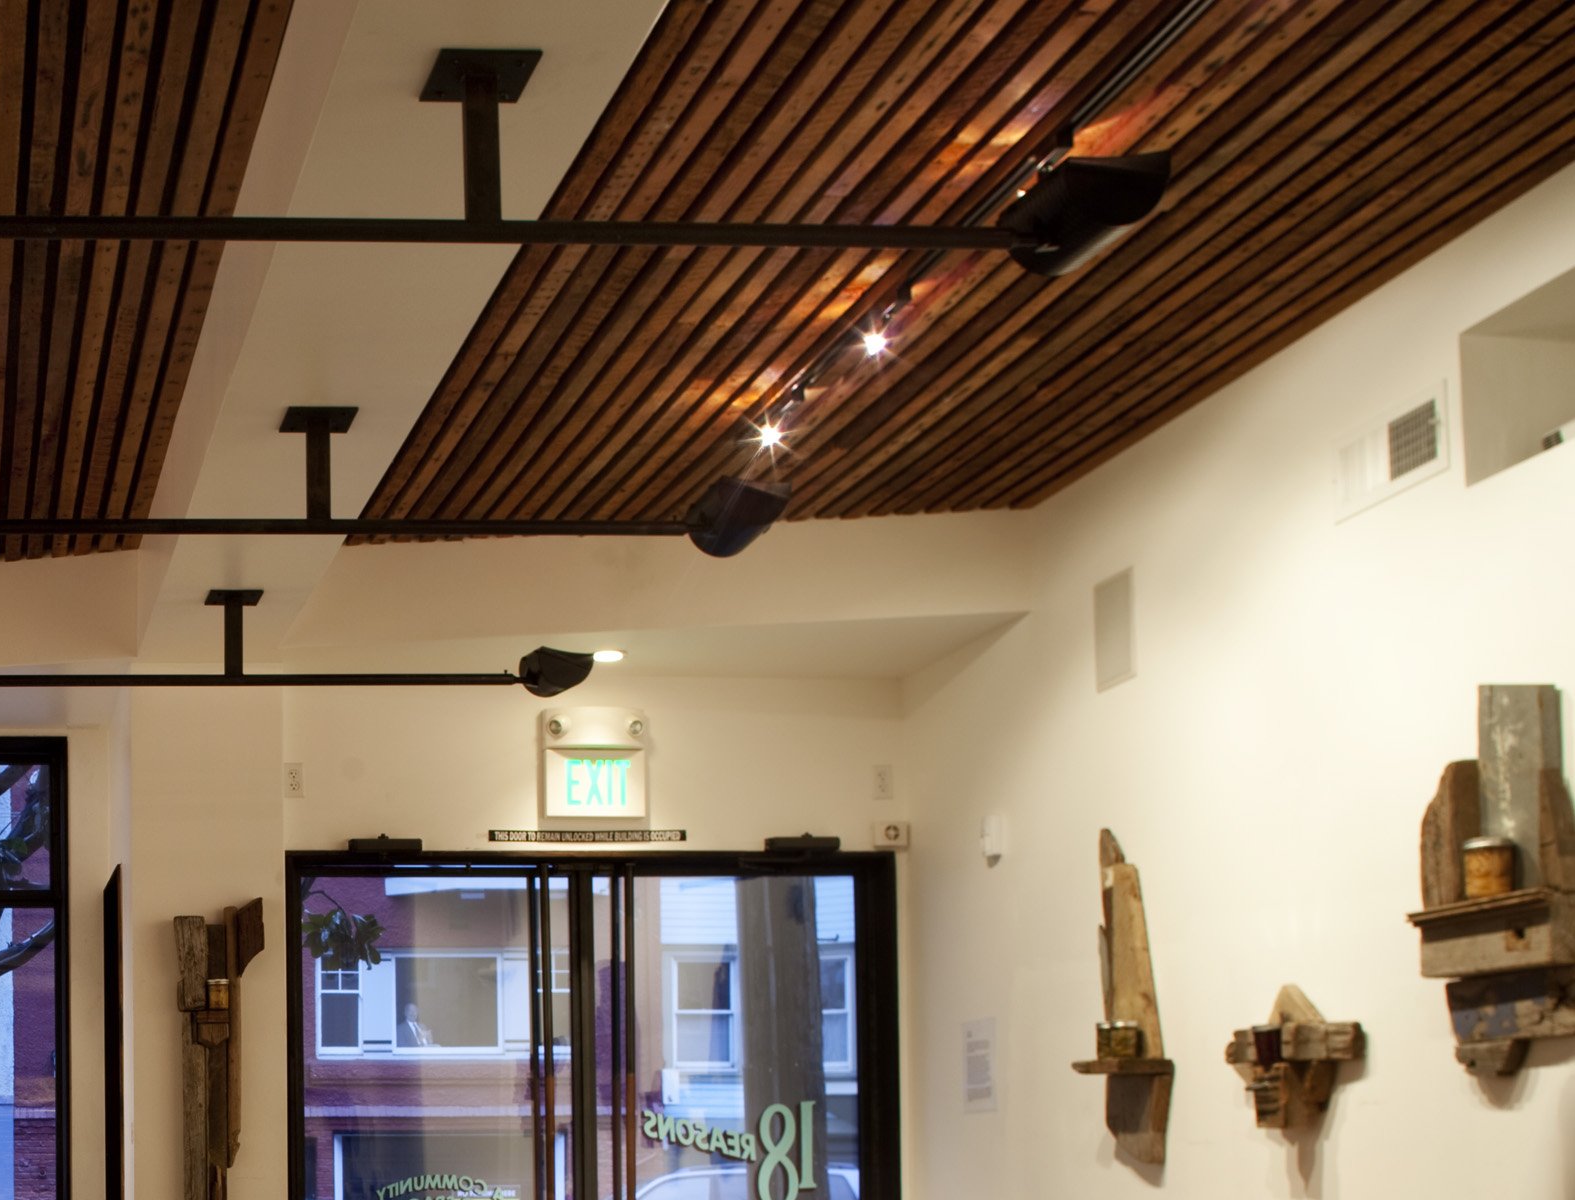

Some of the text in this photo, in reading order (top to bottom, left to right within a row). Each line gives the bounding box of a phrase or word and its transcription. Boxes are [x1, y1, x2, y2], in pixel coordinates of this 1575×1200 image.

[564, 759, 631, 805] EXIT
[494, 831, 681, 842] THIS DOOR TO REMAIN UNLOCKED WHILE BUILDING IS OCCUPIED
